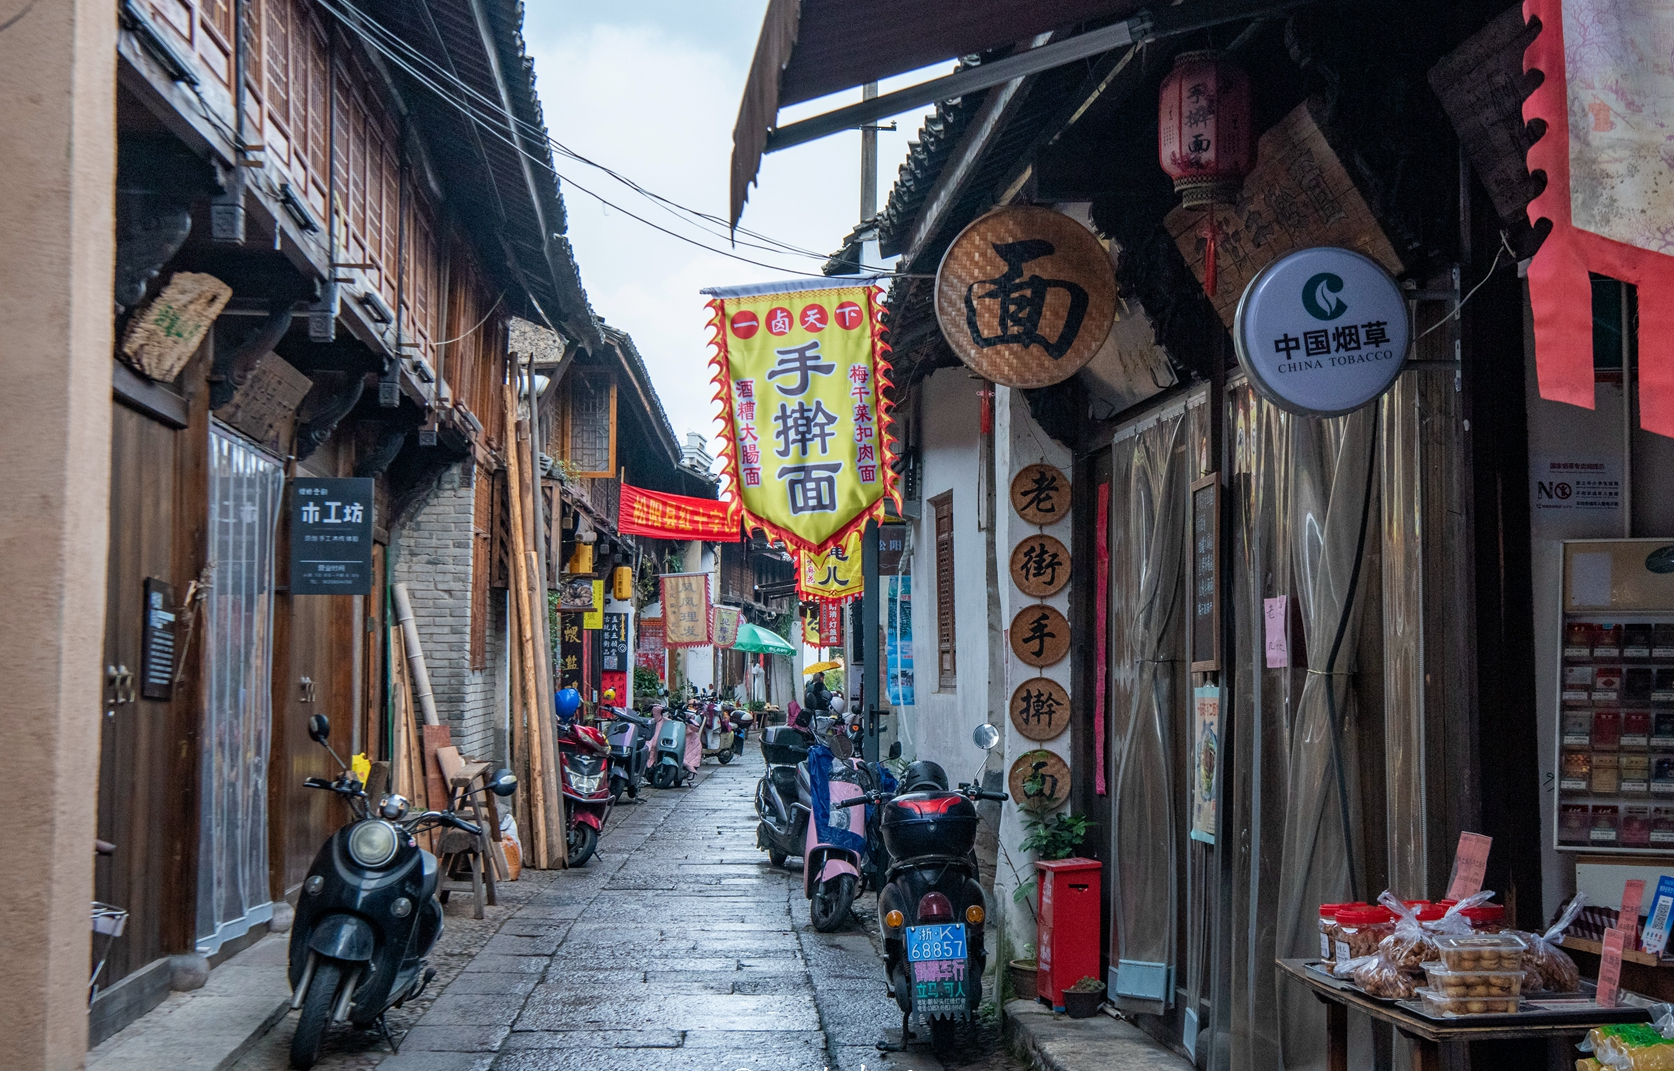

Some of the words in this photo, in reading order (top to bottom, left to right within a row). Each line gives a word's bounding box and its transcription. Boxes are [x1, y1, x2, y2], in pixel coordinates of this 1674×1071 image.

[964, 238, 1089, 360] 面
[733, 305, 859, 334] 一卤天下
[1274, 320, 1390, 360] 中国烟草
[1278, 360, 1323, 373] CHINA
[1328, 350, 1393, 366] TOBACCO
[767, 340, 843, 516] 手擀面
[849, 364, 876, 483] 梅干菜扣肉面
[301, 501, 364, 524] 木工坊
[911, 941, 963, 959] 68857
